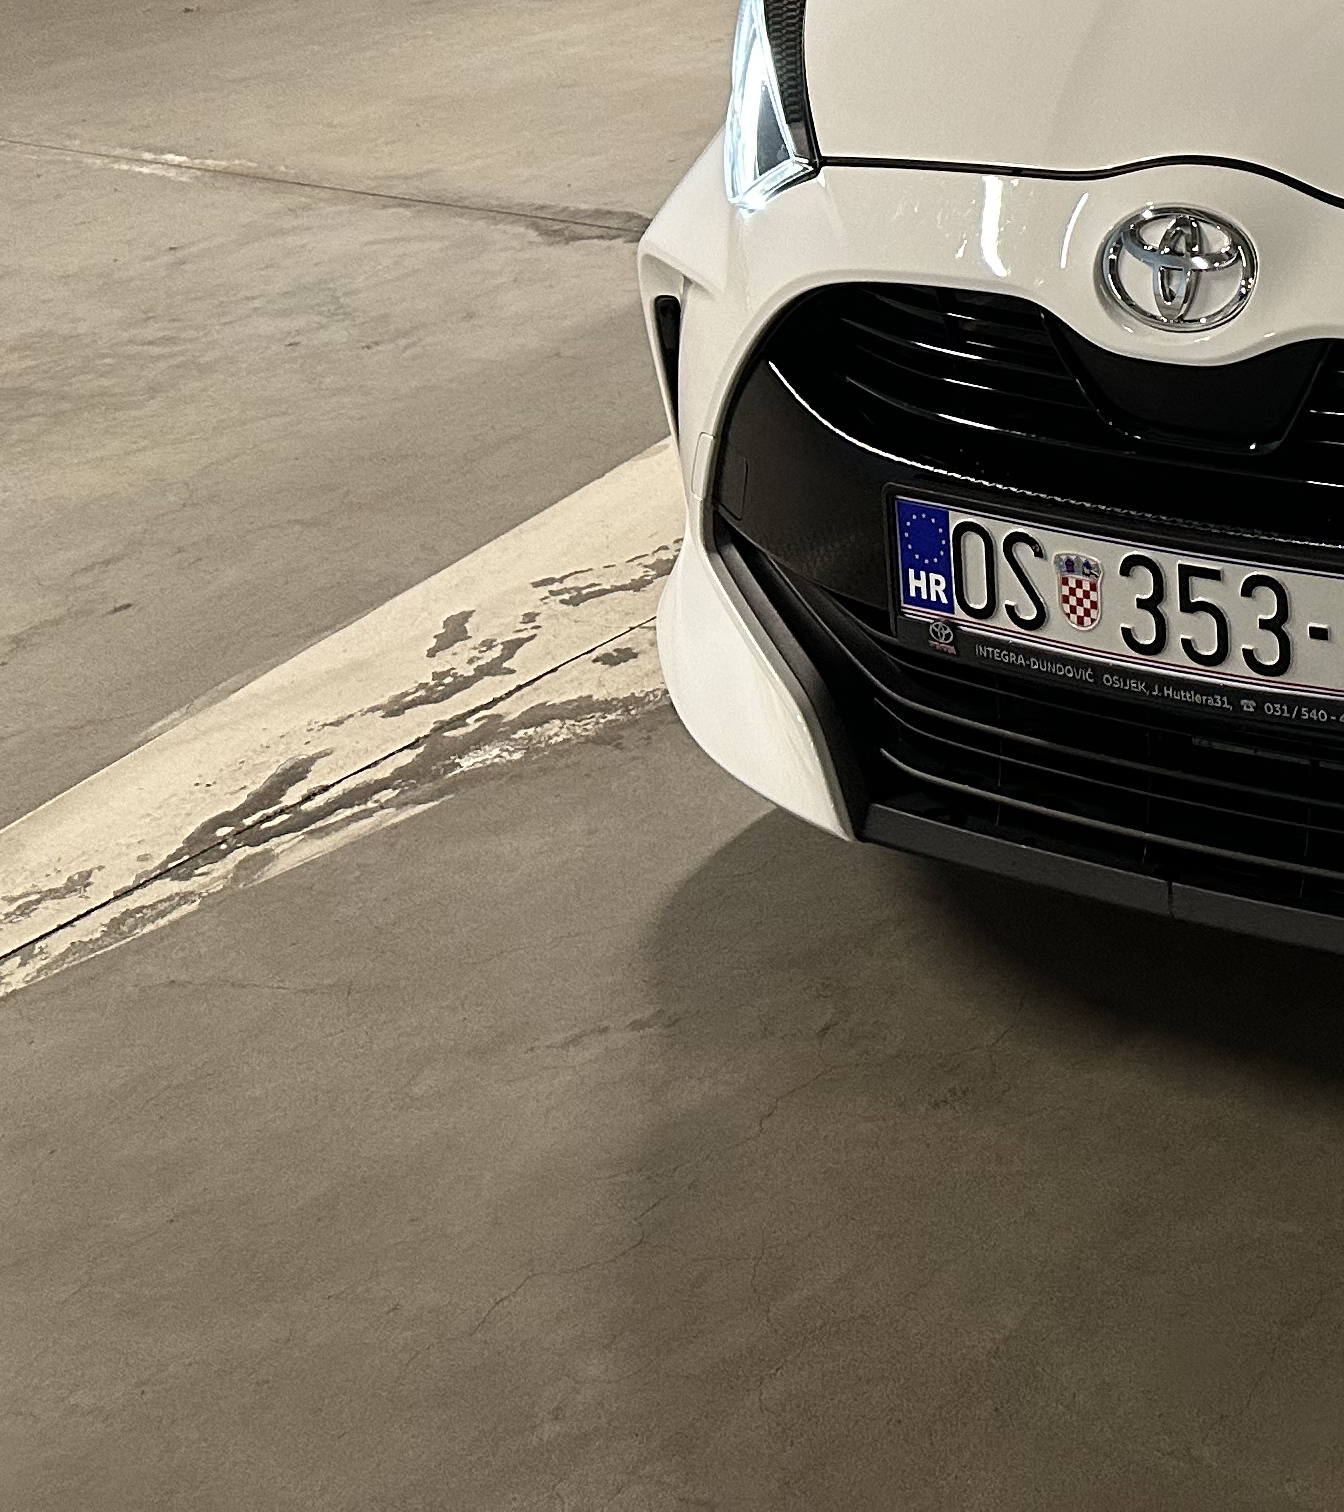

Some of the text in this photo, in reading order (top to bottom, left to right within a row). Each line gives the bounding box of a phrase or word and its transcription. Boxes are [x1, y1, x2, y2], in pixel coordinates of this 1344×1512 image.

[908, 568, 949, 604] HR
[952, 520, 1047, 631] OS
[975, 644, 1094, 682] INTEGRA-DUNDOVIĆ
[1103, 674, 1150, 696] OSIJEK,
